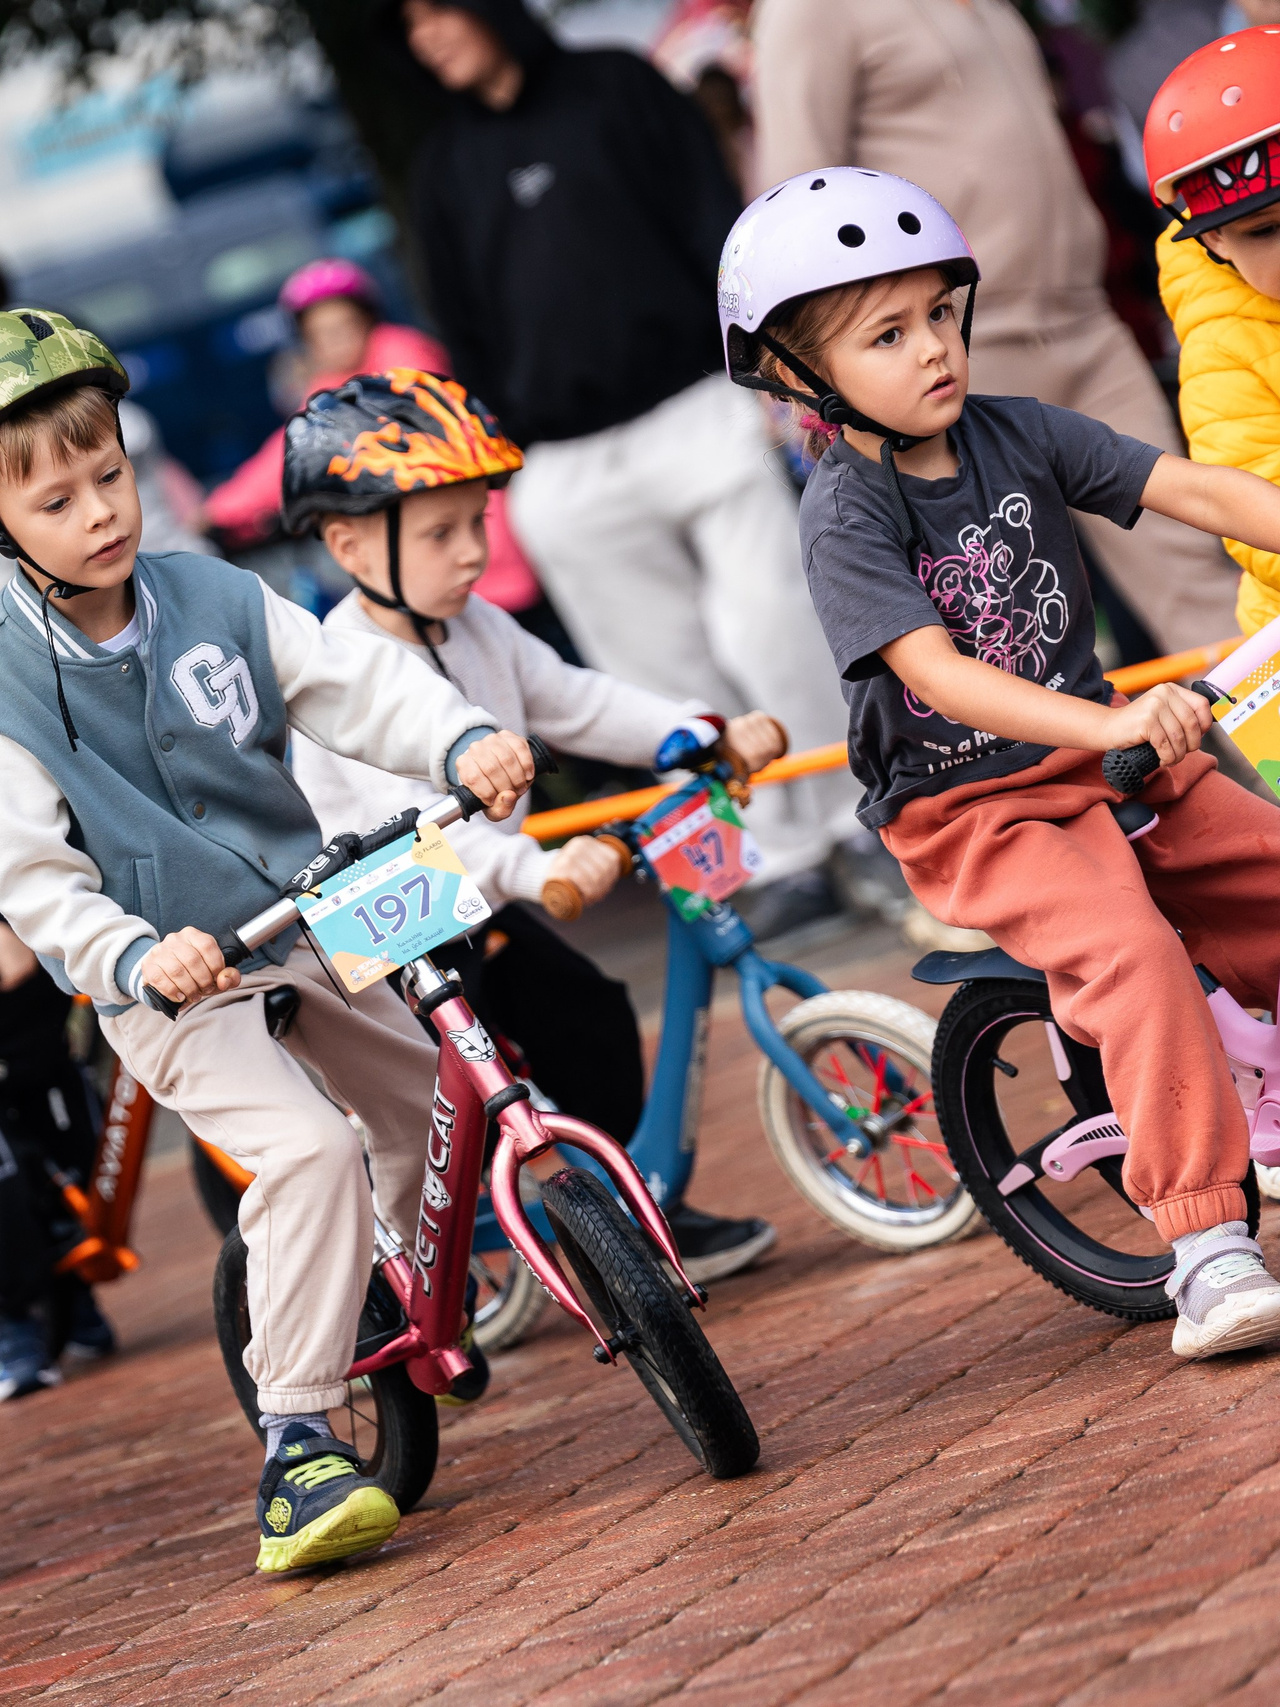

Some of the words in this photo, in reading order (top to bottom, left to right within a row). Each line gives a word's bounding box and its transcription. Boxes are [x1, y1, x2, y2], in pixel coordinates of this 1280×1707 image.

[680, 826, 725, 876] 47
[352, 872, 431, 946] 197
[95, 1061, 138, 1202] AVIATO
[413, 1196, 441, 1298] JET
[427, 1073, 456, 1174] CAT
